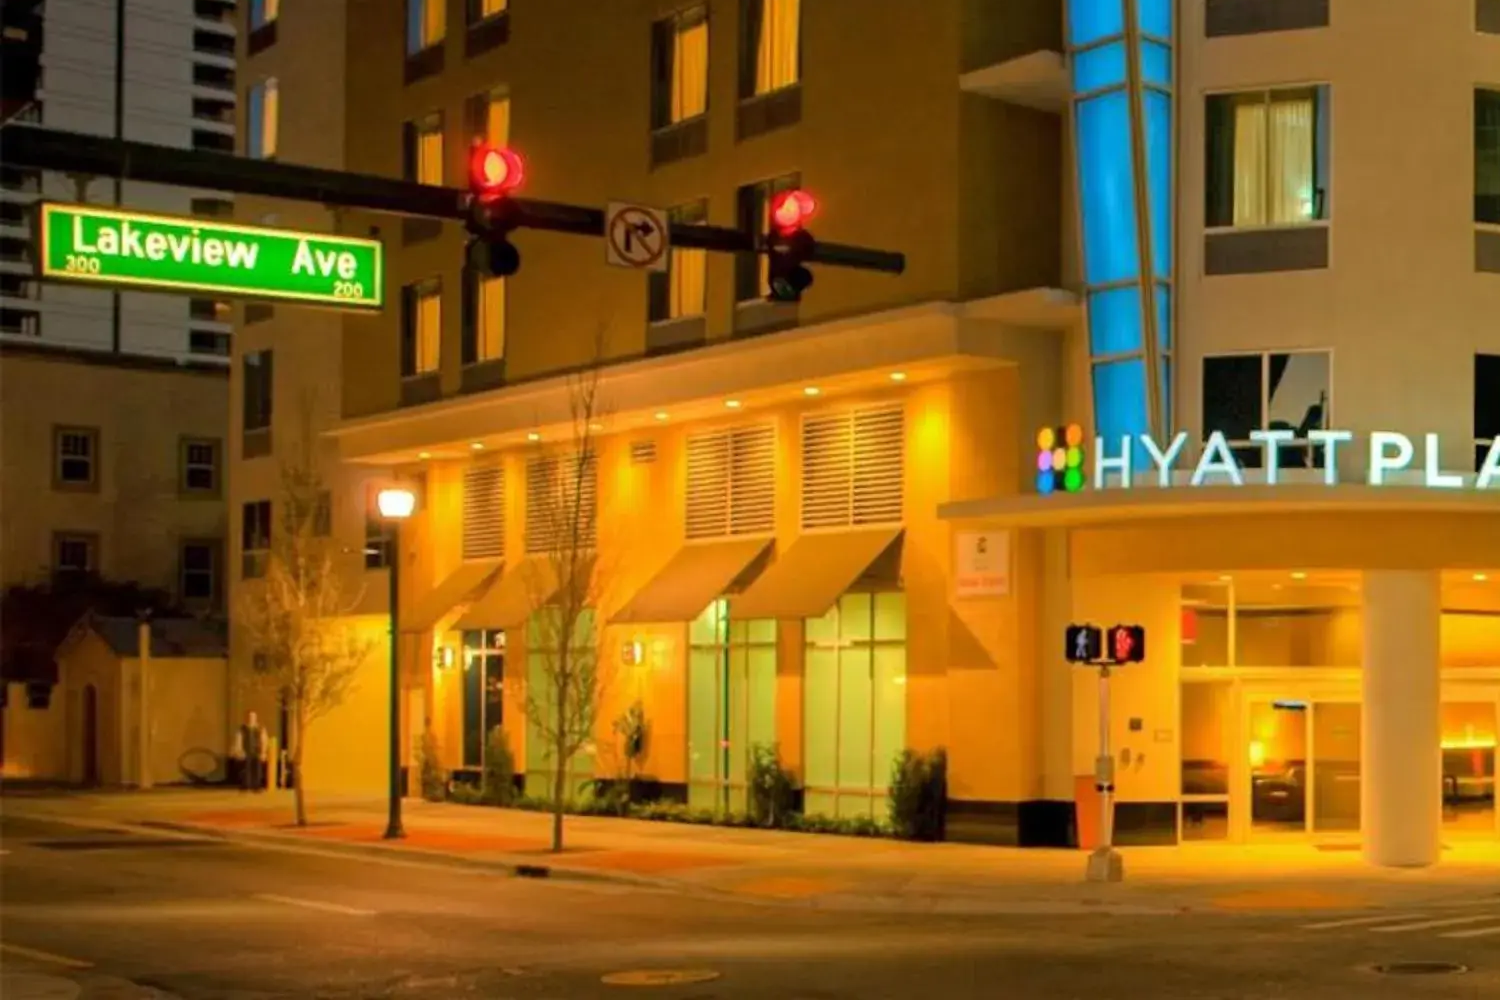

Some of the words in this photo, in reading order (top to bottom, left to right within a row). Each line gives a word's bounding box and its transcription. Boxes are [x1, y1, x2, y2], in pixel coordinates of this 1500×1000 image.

[65, 254, 101, 275] 300
[72, 215, 260, 270] Lakeview
[291, 238, 358, 280] Ave
[333, 280, 363, 299] 200
[1093, 429, 1353, 490] HYATT
